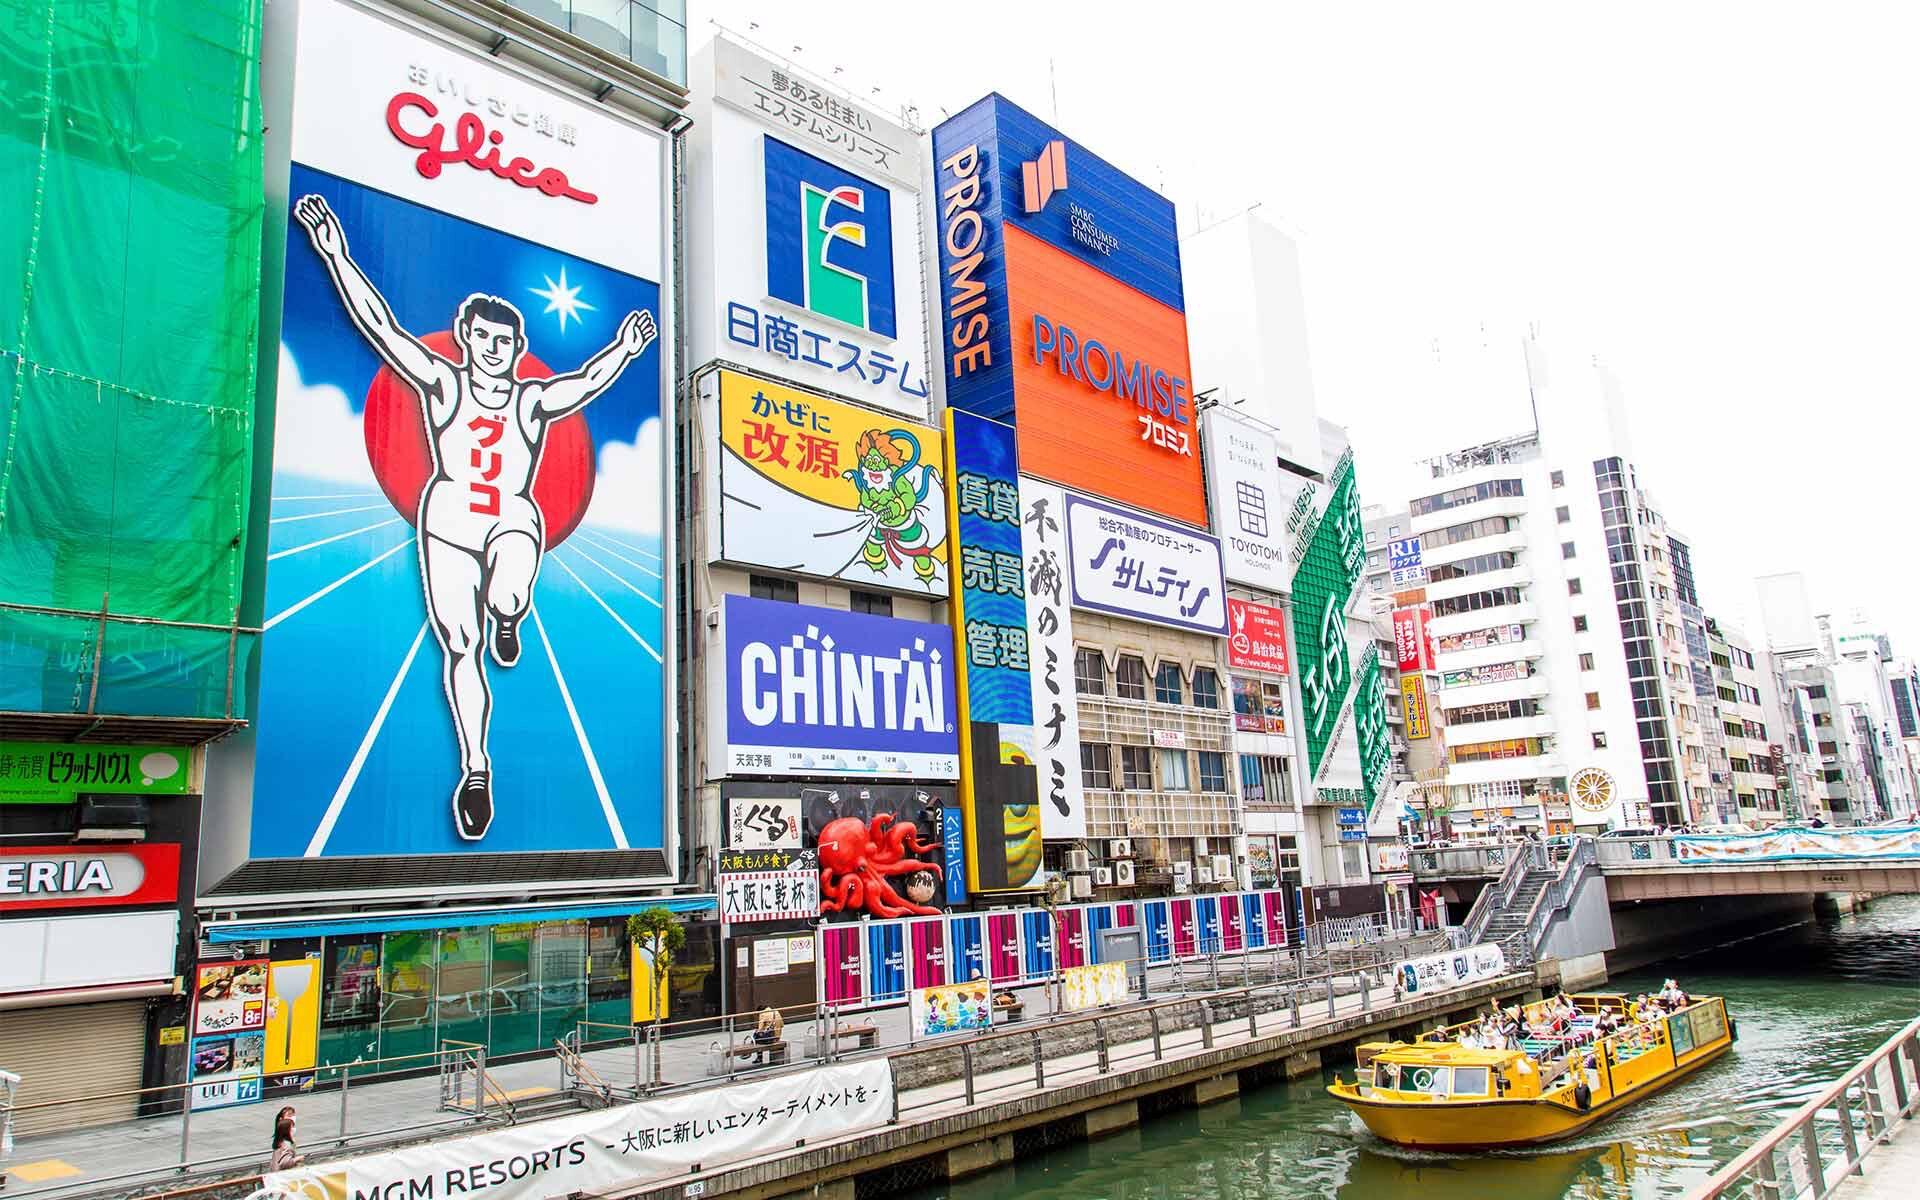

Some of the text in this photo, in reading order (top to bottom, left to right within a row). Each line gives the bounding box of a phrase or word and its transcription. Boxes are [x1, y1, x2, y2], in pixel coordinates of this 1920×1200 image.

[772, 70, 871, 131] 夢ある住まい
[385, 92, 598, 205] Glico
[754, 91, 889, 169] エステムシリーズ
[1070, 202, 1096, 226] SMBC
[1070, 214, 1120, 250] CONSUMER
[943, 144, 992, 378] PROMISE
[1072, 226, 1111, 257] FINANCE
[728, 301, 928, 398] 日商エステム
[1031, 312, 1190, 425] PROMISE
[751, 390, 832, 433] かぜに
[1138, 414, 1192, 457] プロミス
[467, 415, 507, 517] グリコ
[742, 419, 840, 479] 改源
[957, 470, 1020, 526] 賃貸
[962, 543, 1025, 599] 売買
[1112, 556, 1191, 601] サムティ
[965, 617, 1030, 672] 管理
[1024, 498, 1070, 817] 不滅のミナミ
[47, 750, 132, 785] ピタットハウス
[735, 753, 772, 768] 天気予報
[743, 804, 789, 842] くくる
[0, 856, 113, 895] ERIA
[721, 853, 792, 870] 大阪もんを食す
[946, 814, 962, 897] ペンギンバー
[726, 879, 807, 914] 大阪に乾杯
[244, 1009, 261, 1024] 8F
[239, 1085, 257, 1098] 7F
[446, 1140, 586, 1195] RESORTS
[621, 1084, 867, 1155] 大阪に新しいエンターテイメントを
